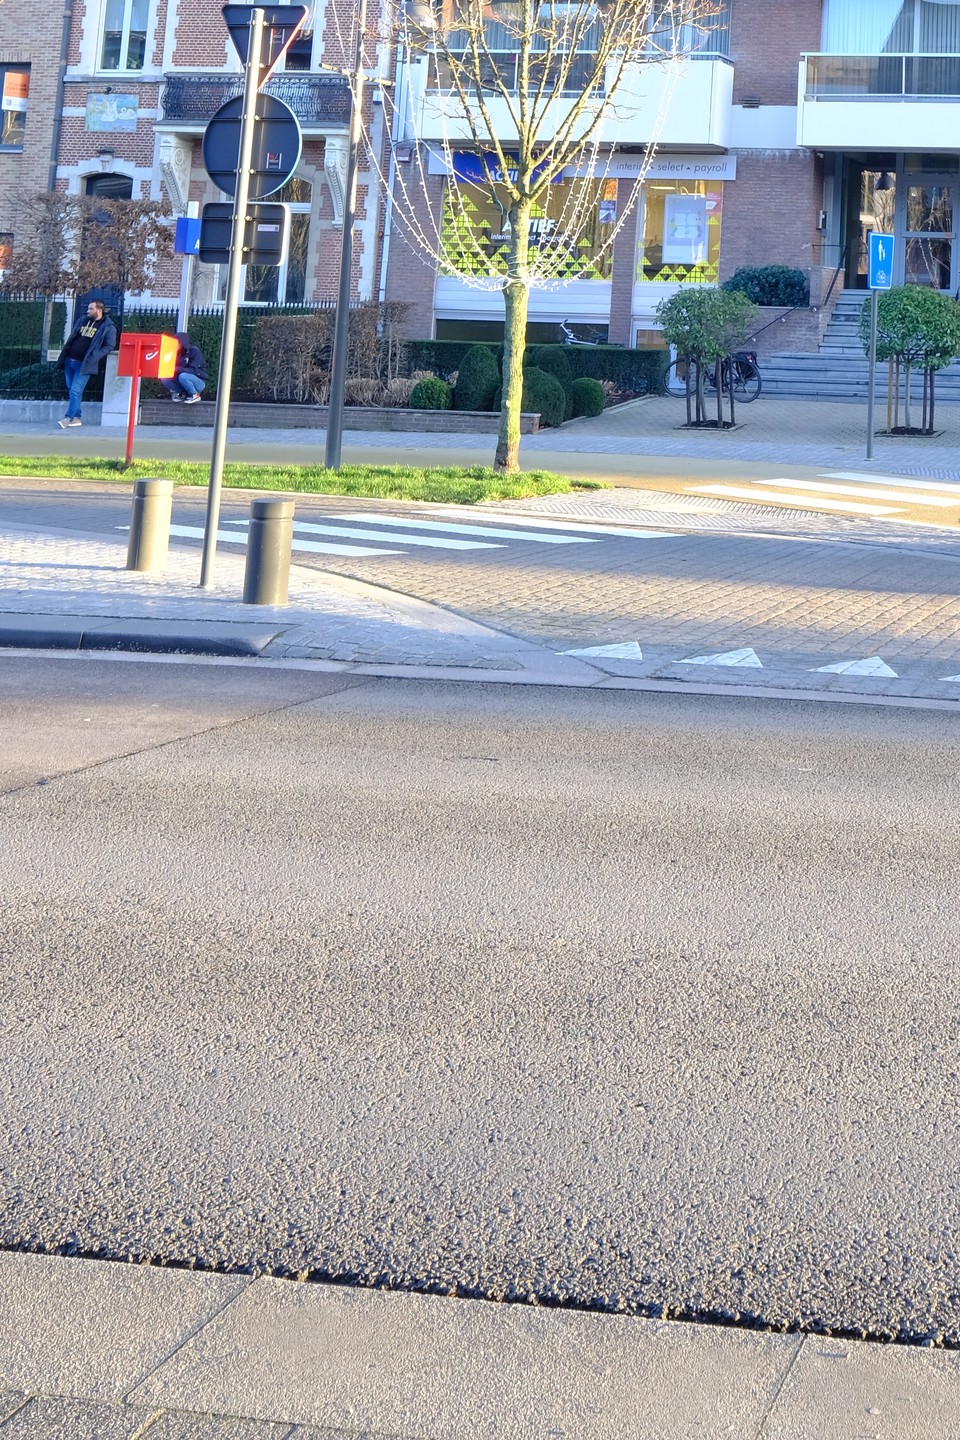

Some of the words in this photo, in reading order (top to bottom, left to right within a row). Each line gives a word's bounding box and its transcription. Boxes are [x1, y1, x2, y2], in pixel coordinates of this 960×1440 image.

[617, 161, 645, 171] interi
[657, 161, 684, 171] select
[694, 162, 728, 174] payroll
[502, 219, 556, 234] ATIEF
